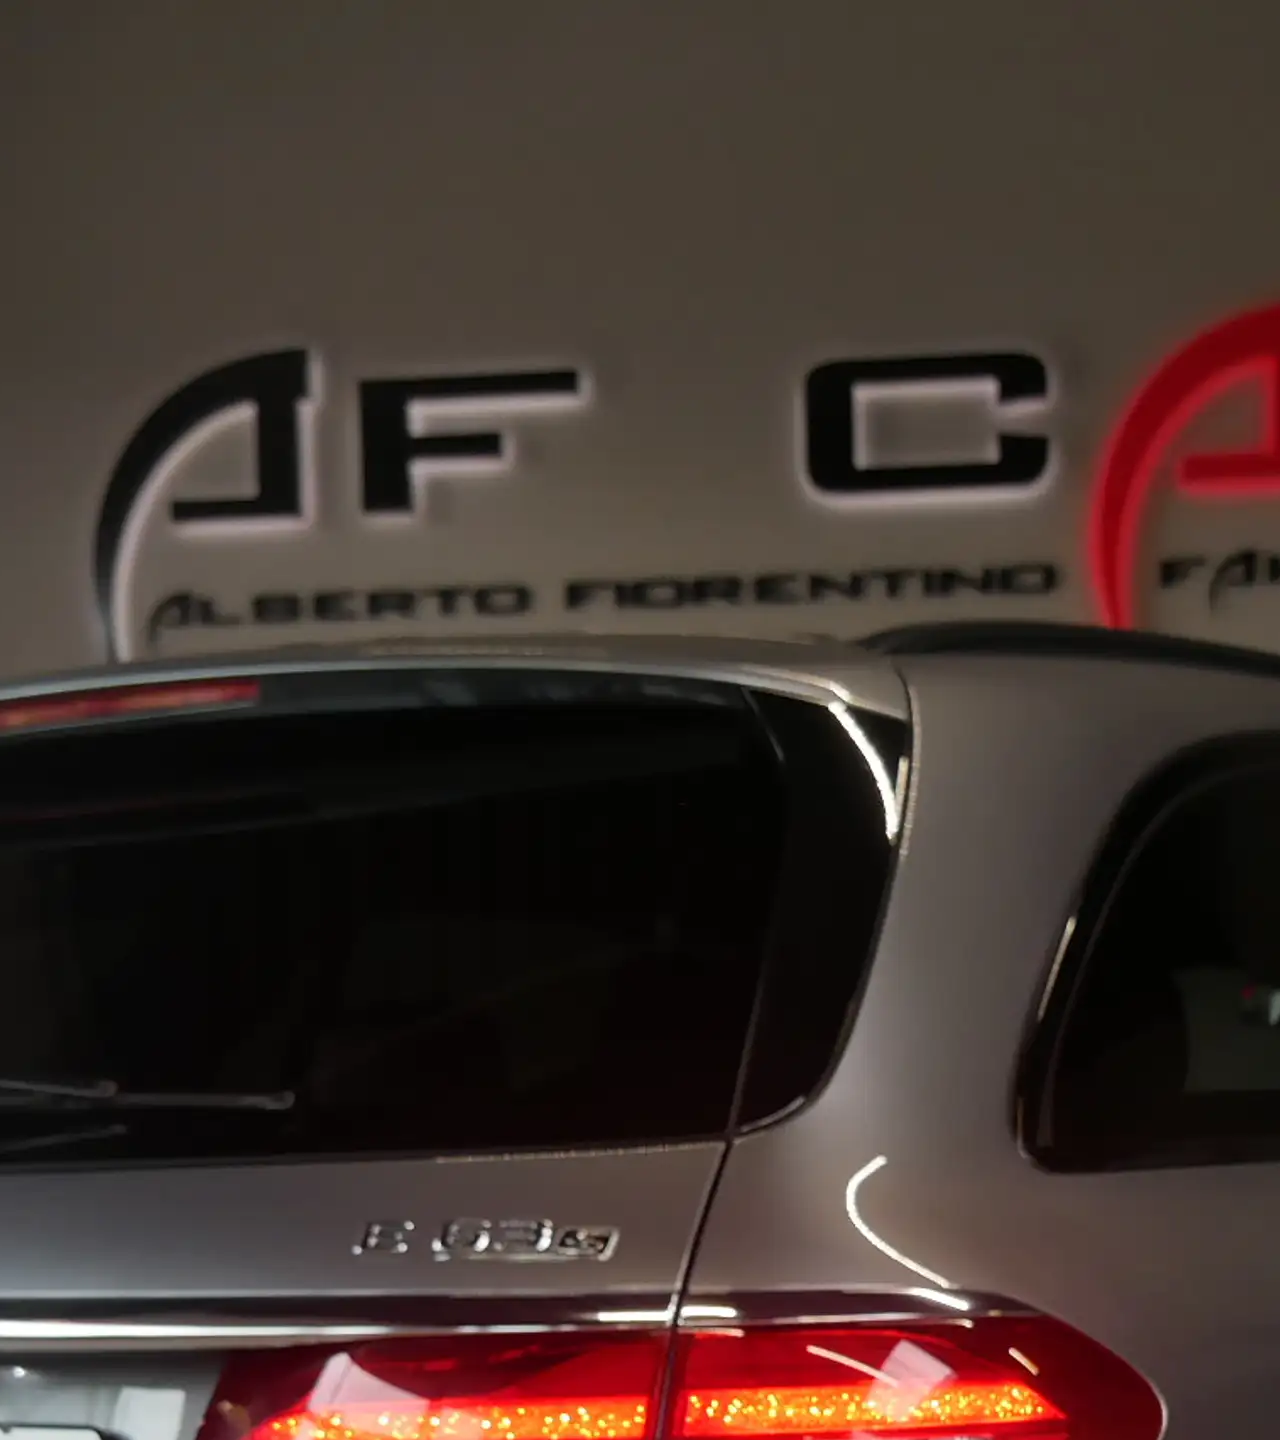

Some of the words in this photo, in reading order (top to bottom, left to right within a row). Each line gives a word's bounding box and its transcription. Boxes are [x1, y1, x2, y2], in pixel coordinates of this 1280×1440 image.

[94, 348, 580, 662] AF
[147, 585, 535, 645] ALBERTO
[562, 560, 1060, 612] FIORENTINO
